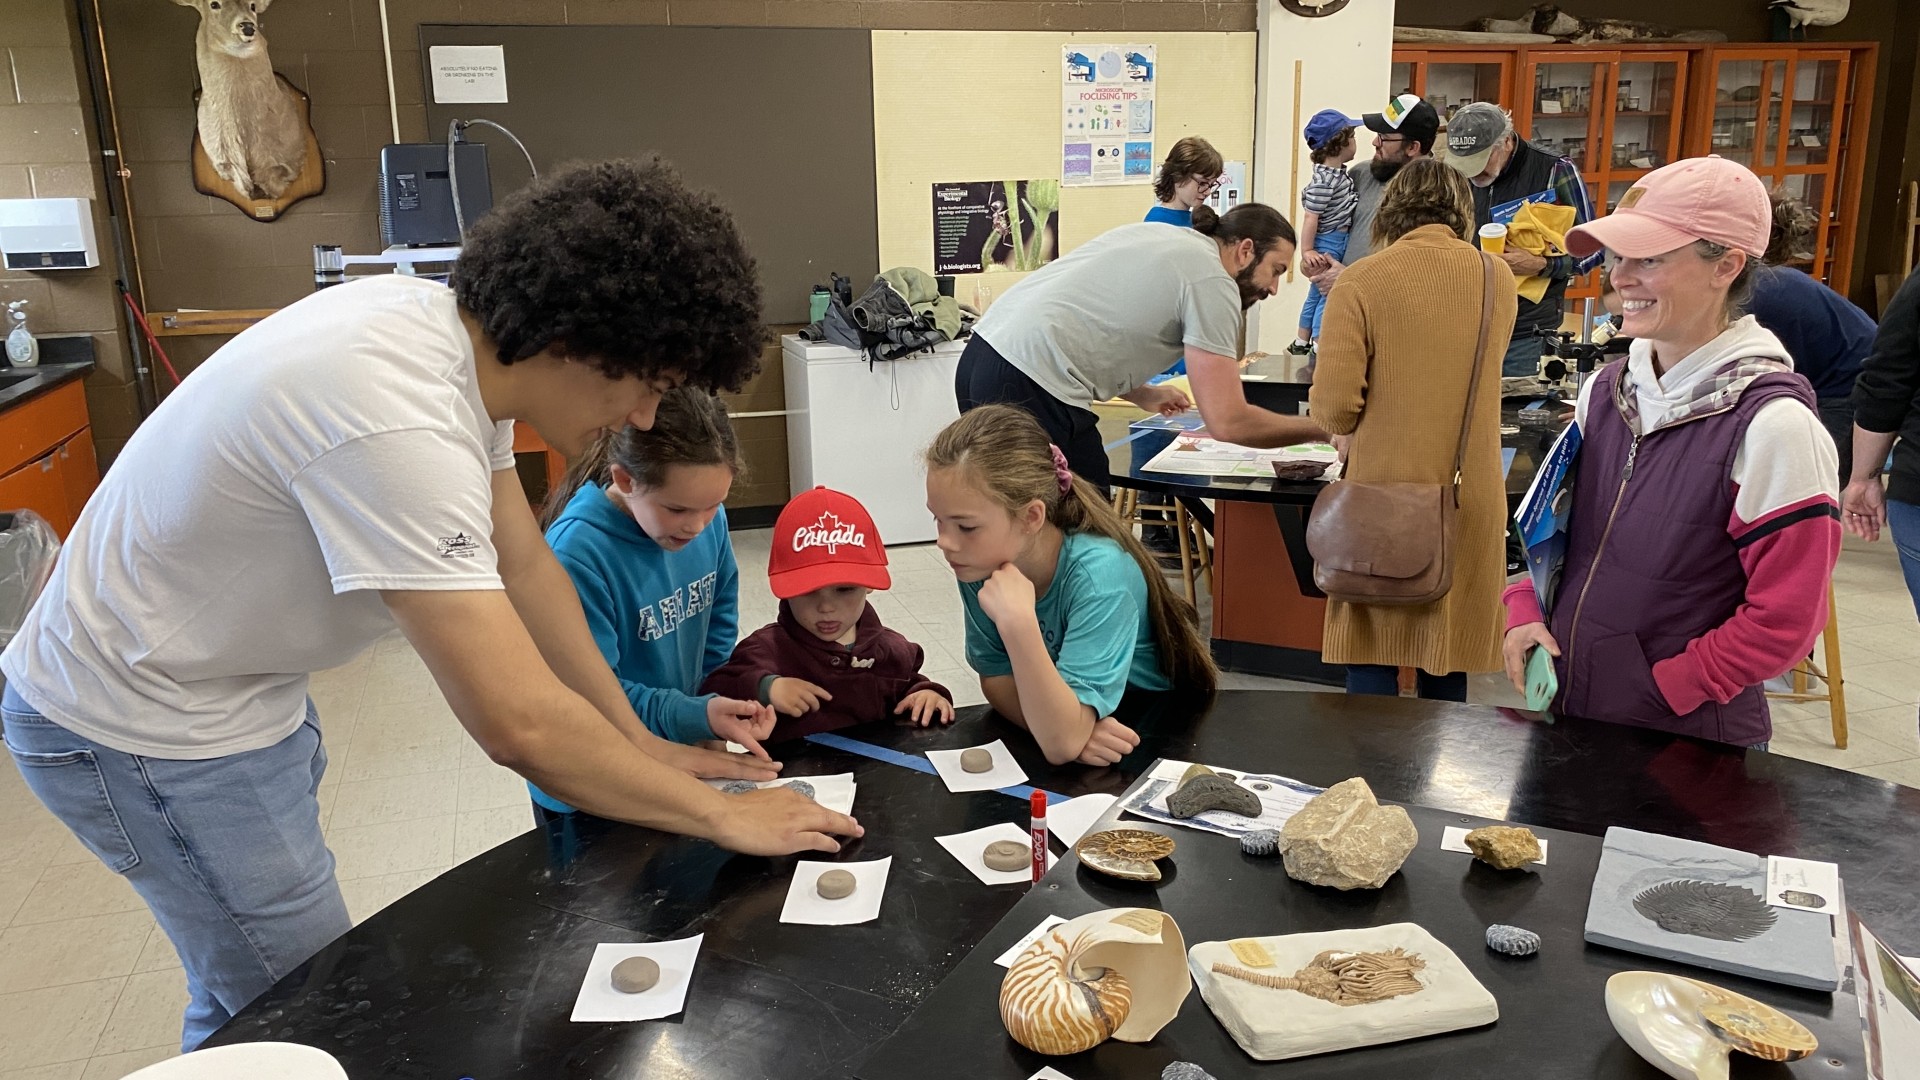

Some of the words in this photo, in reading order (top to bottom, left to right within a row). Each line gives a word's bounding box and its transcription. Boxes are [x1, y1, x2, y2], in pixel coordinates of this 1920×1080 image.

[1080, 92, 1120, 100] FOCUSING
[1122, 92, 1138, 100] TIPS
[939, 262, 981, 271] jb.biologists.org
[1545, 463, 1553, 479] Risk
[1546, 465, 1560, 499] aquatiques
[1558, 455, 1564, 464] en
[1561, 438, 1569, 456] péril
[793, 524, 865, 552] Canada
[638, 571, 717, 641] ARIAT
